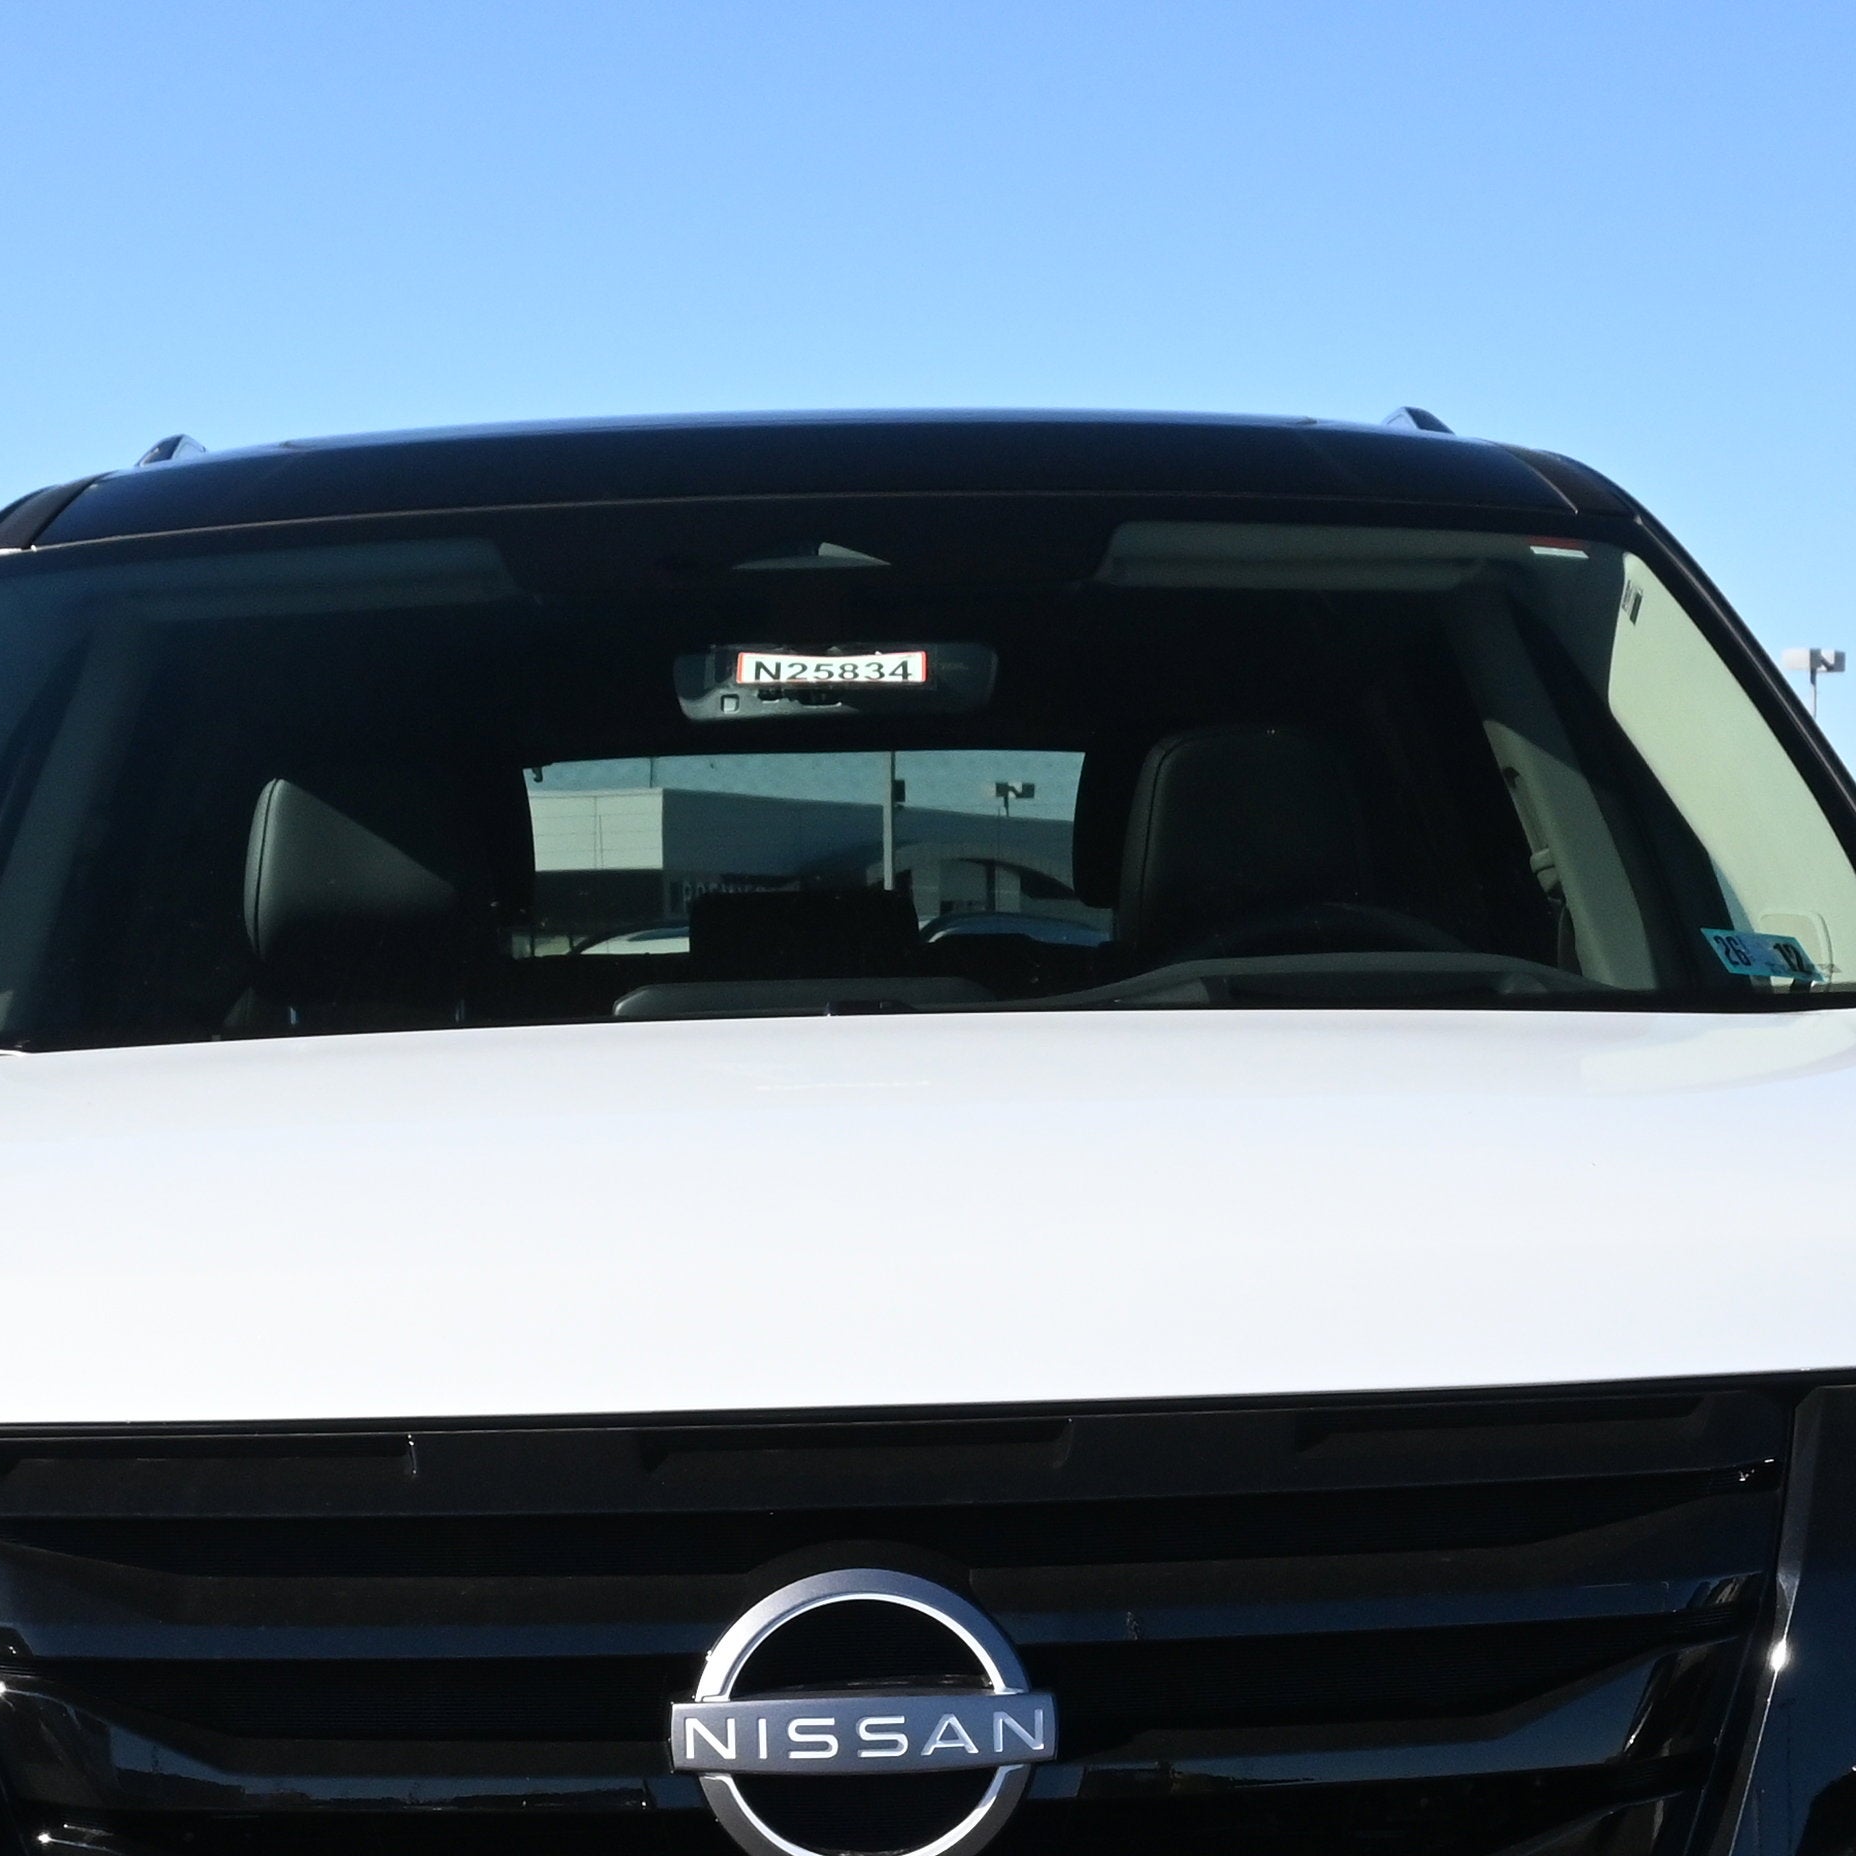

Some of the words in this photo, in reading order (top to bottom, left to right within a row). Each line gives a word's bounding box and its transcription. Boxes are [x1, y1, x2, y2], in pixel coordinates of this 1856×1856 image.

[754, 659, 913, 681] N25834
[1713, 935, 1751, 966] 26
[684, 1708, 1045, 1760] NISSAN
